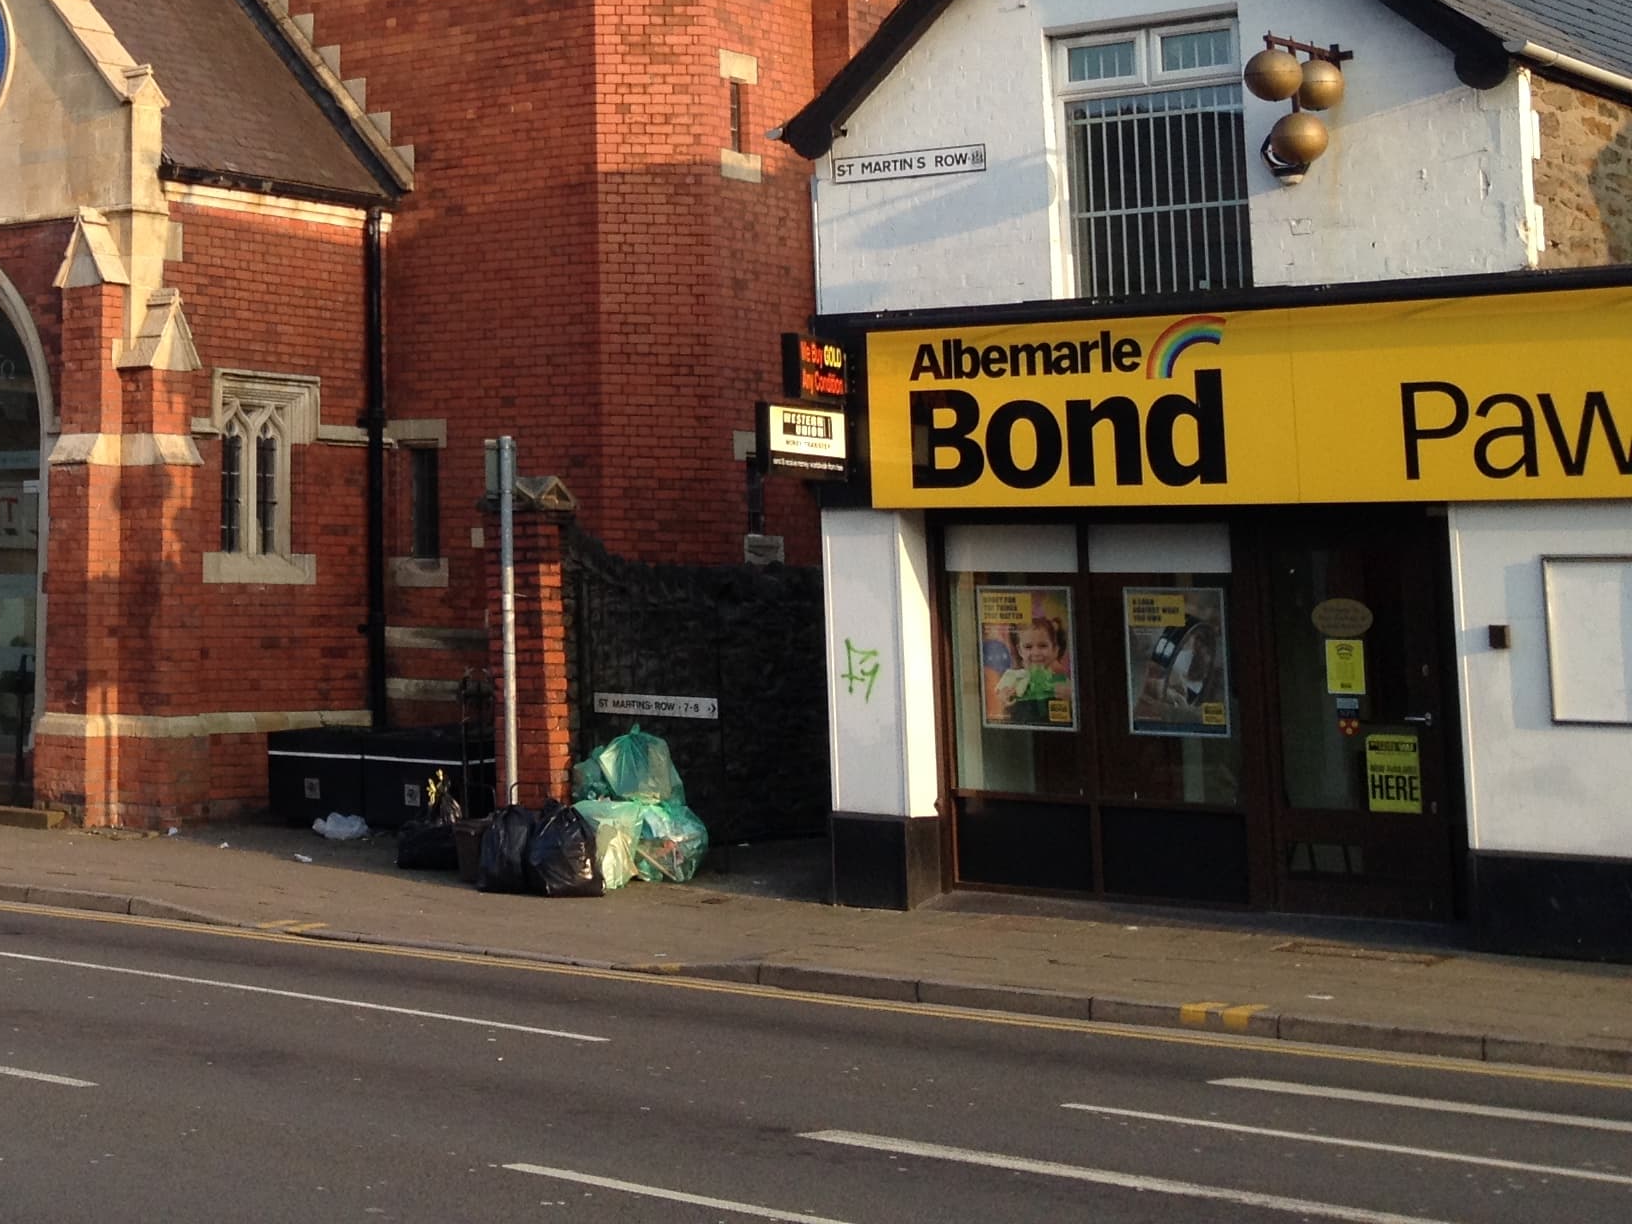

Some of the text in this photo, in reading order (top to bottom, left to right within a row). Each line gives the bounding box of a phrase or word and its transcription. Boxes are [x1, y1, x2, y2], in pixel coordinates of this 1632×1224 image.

[837, 163, 855, 177] ST
[934, 152, 968, 167] ROW
[811, 342, 823, 368] Buy
[824, 344, 842, 368] GOLD
[910, 331, 1142, 381] Albemarle
[802, 369, 845, 395] Any Condition
[783, 412, 825, 428] WESTERN
[795, 424, 824, 438] UNION
[909, 368, 1228, 489] Bond
[1399, 380, 1632, 482] Paw
[654, 701, 675, 711] ROW
[1370, 774, 1419, 801] HERE
